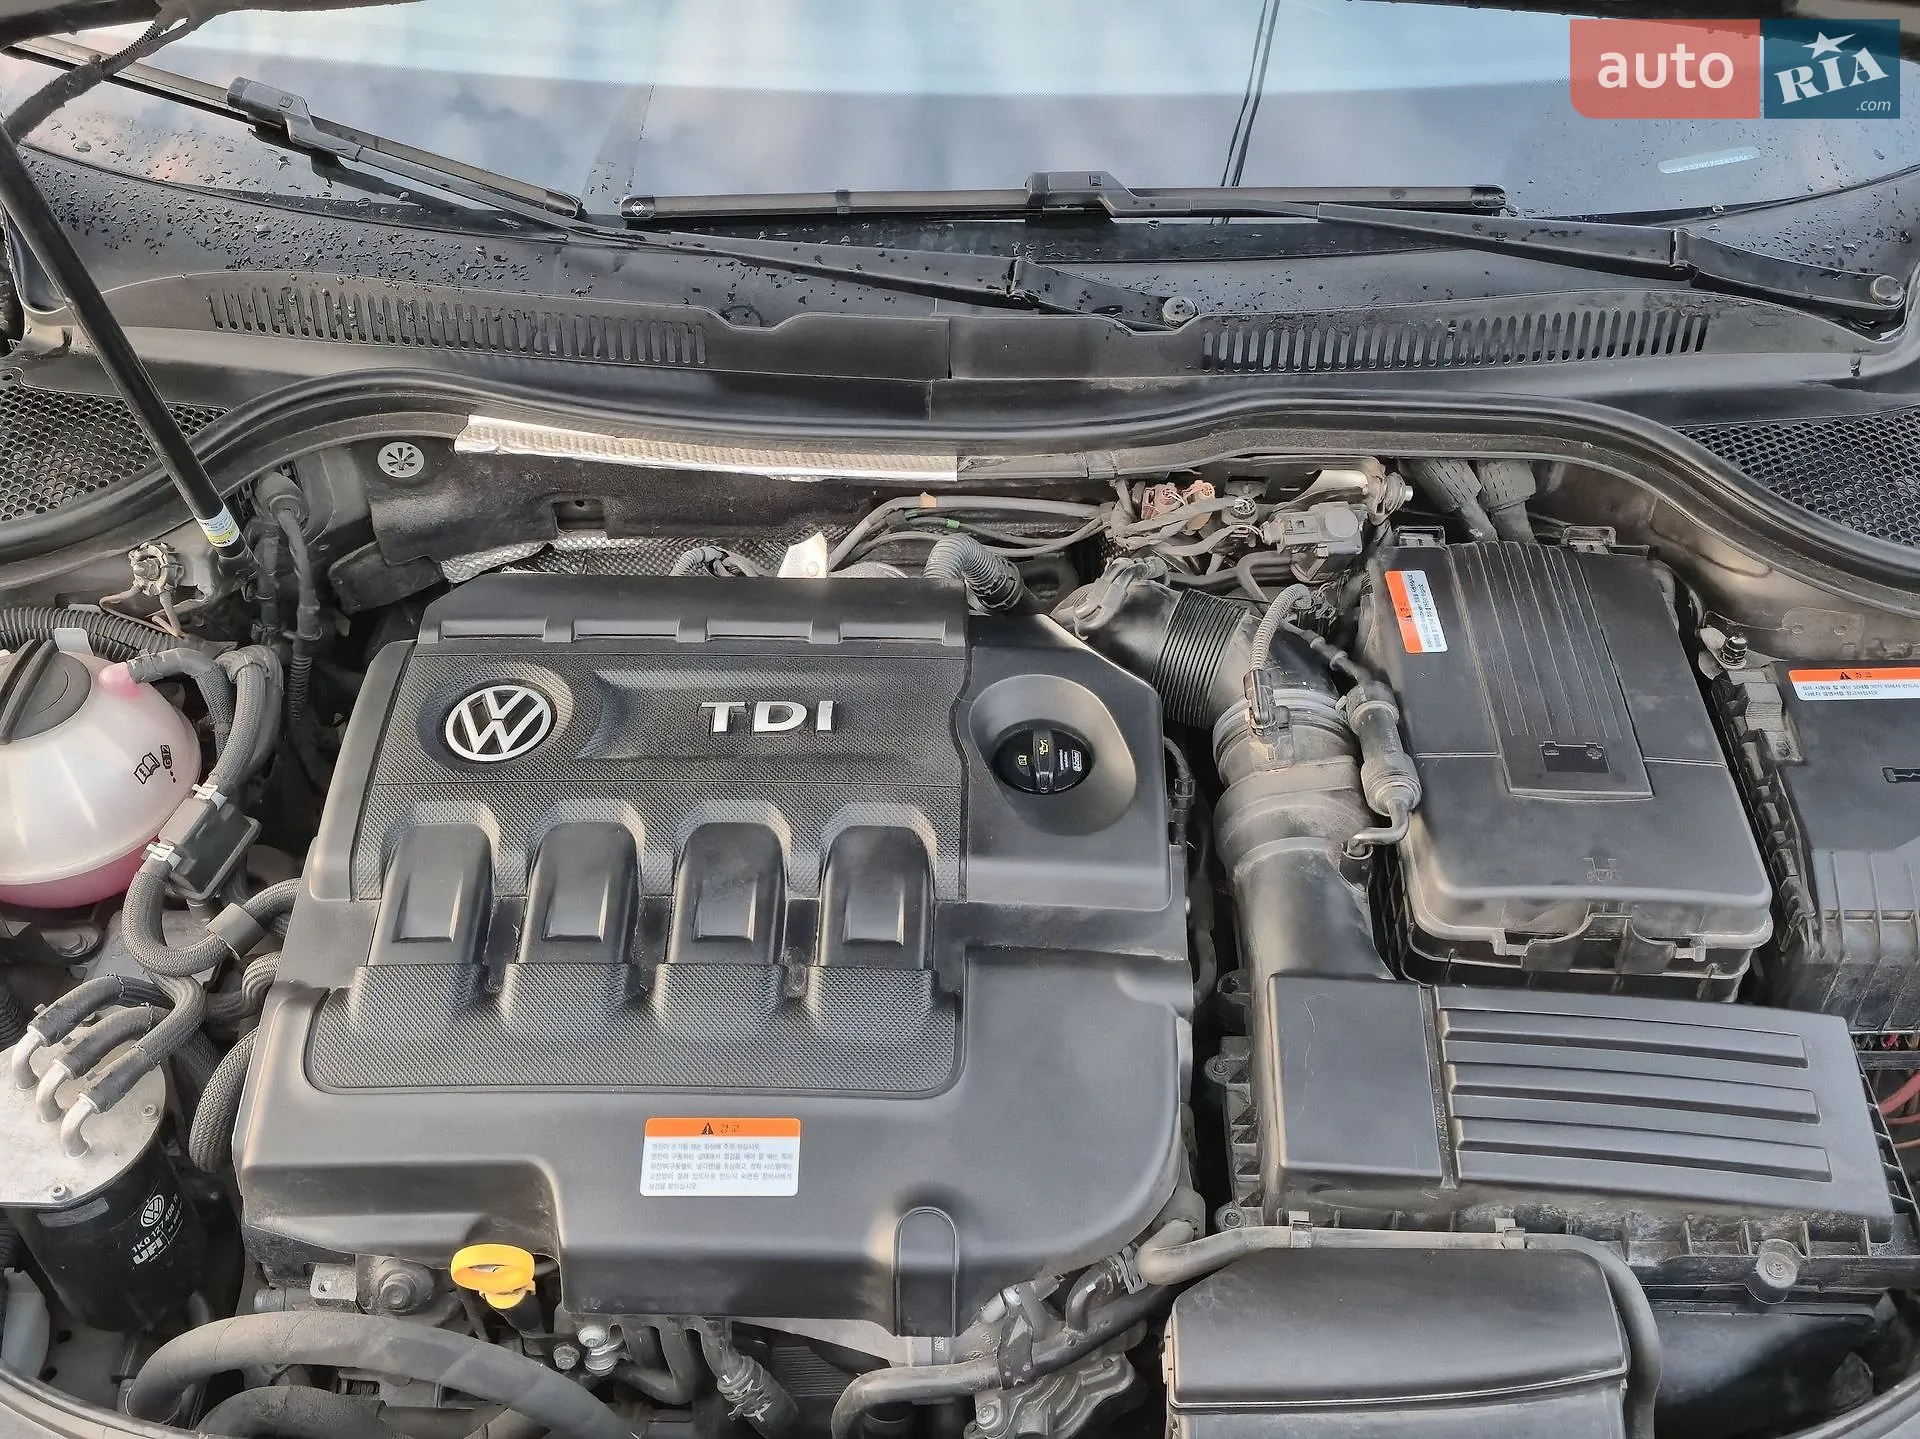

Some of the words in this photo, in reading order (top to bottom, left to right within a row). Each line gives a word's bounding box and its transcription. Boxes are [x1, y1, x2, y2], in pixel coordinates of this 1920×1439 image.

[701, 700, 834, 732] TDI
[151, 1220, 164, 1237] 127
[133, 1237, 164, 1265] UFI
